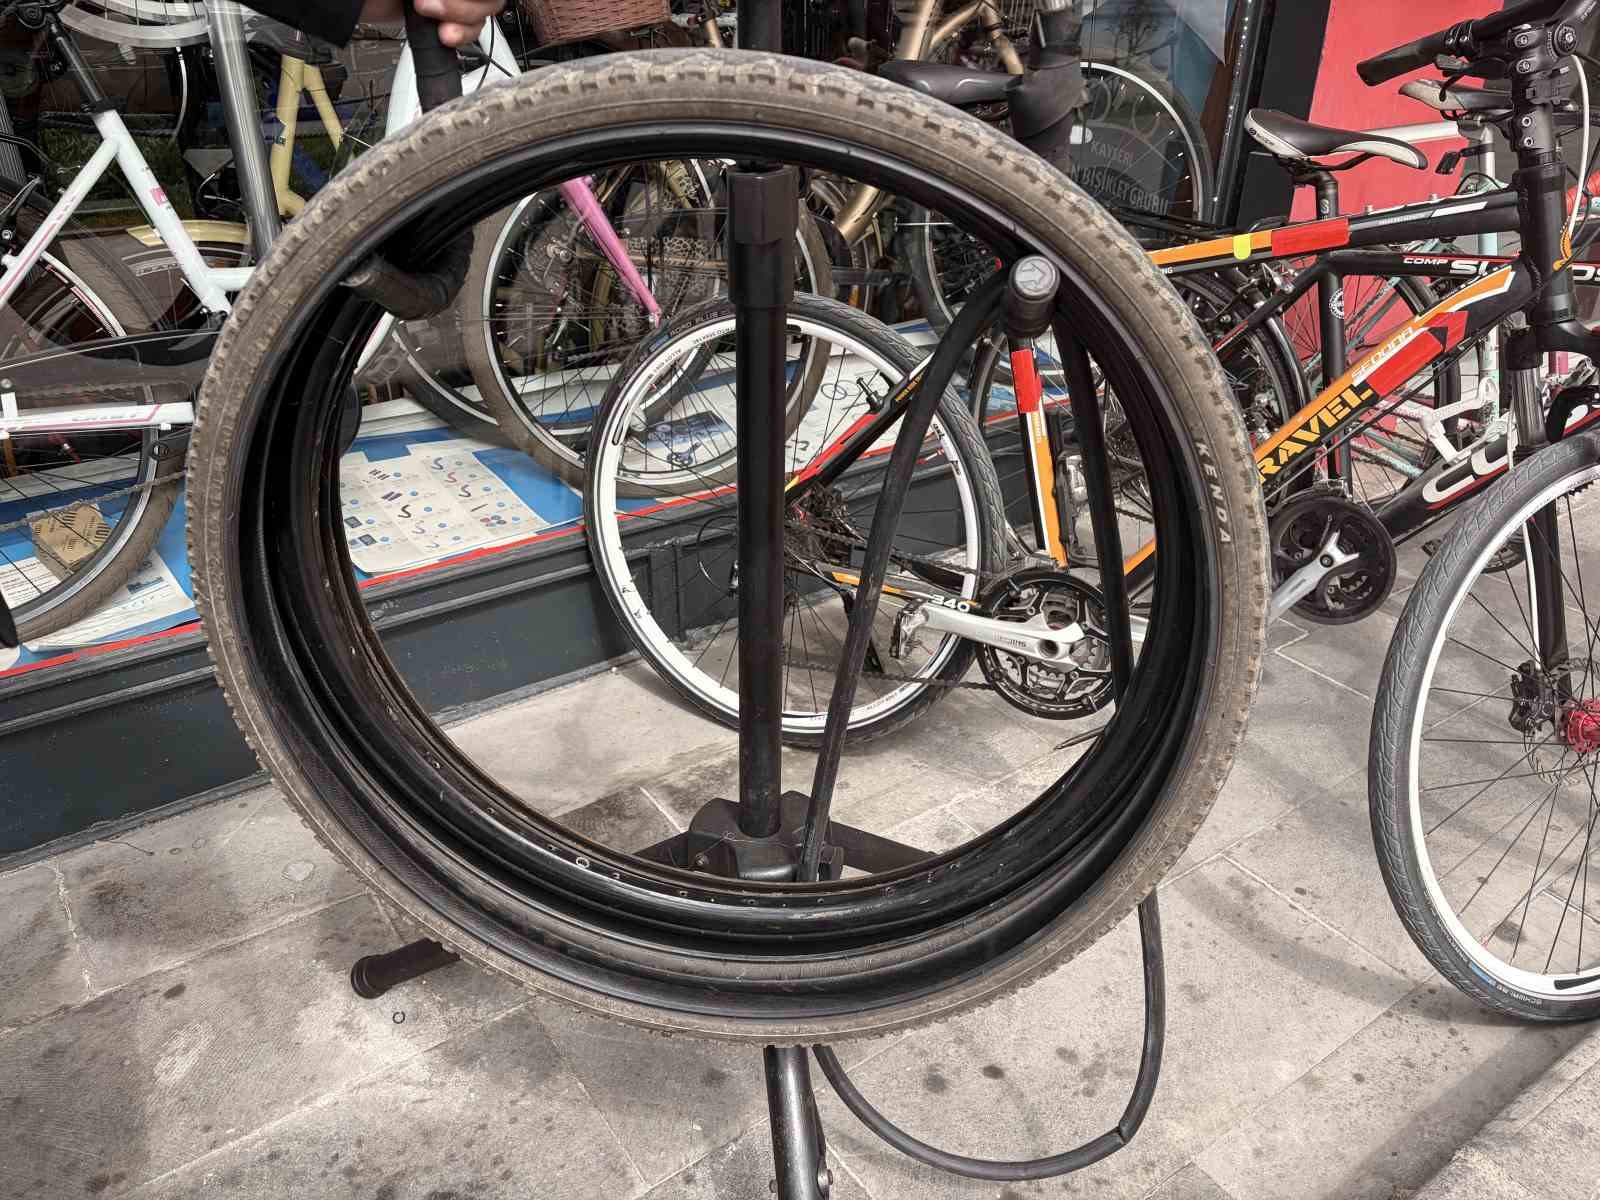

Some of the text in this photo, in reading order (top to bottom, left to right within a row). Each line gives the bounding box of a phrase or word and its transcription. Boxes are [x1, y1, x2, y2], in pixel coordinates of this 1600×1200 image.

[1403, 257, 1448, 265] COMP
[1194, 442, 1231, 543] KENDA
[931, 593, 970, 613] 340
